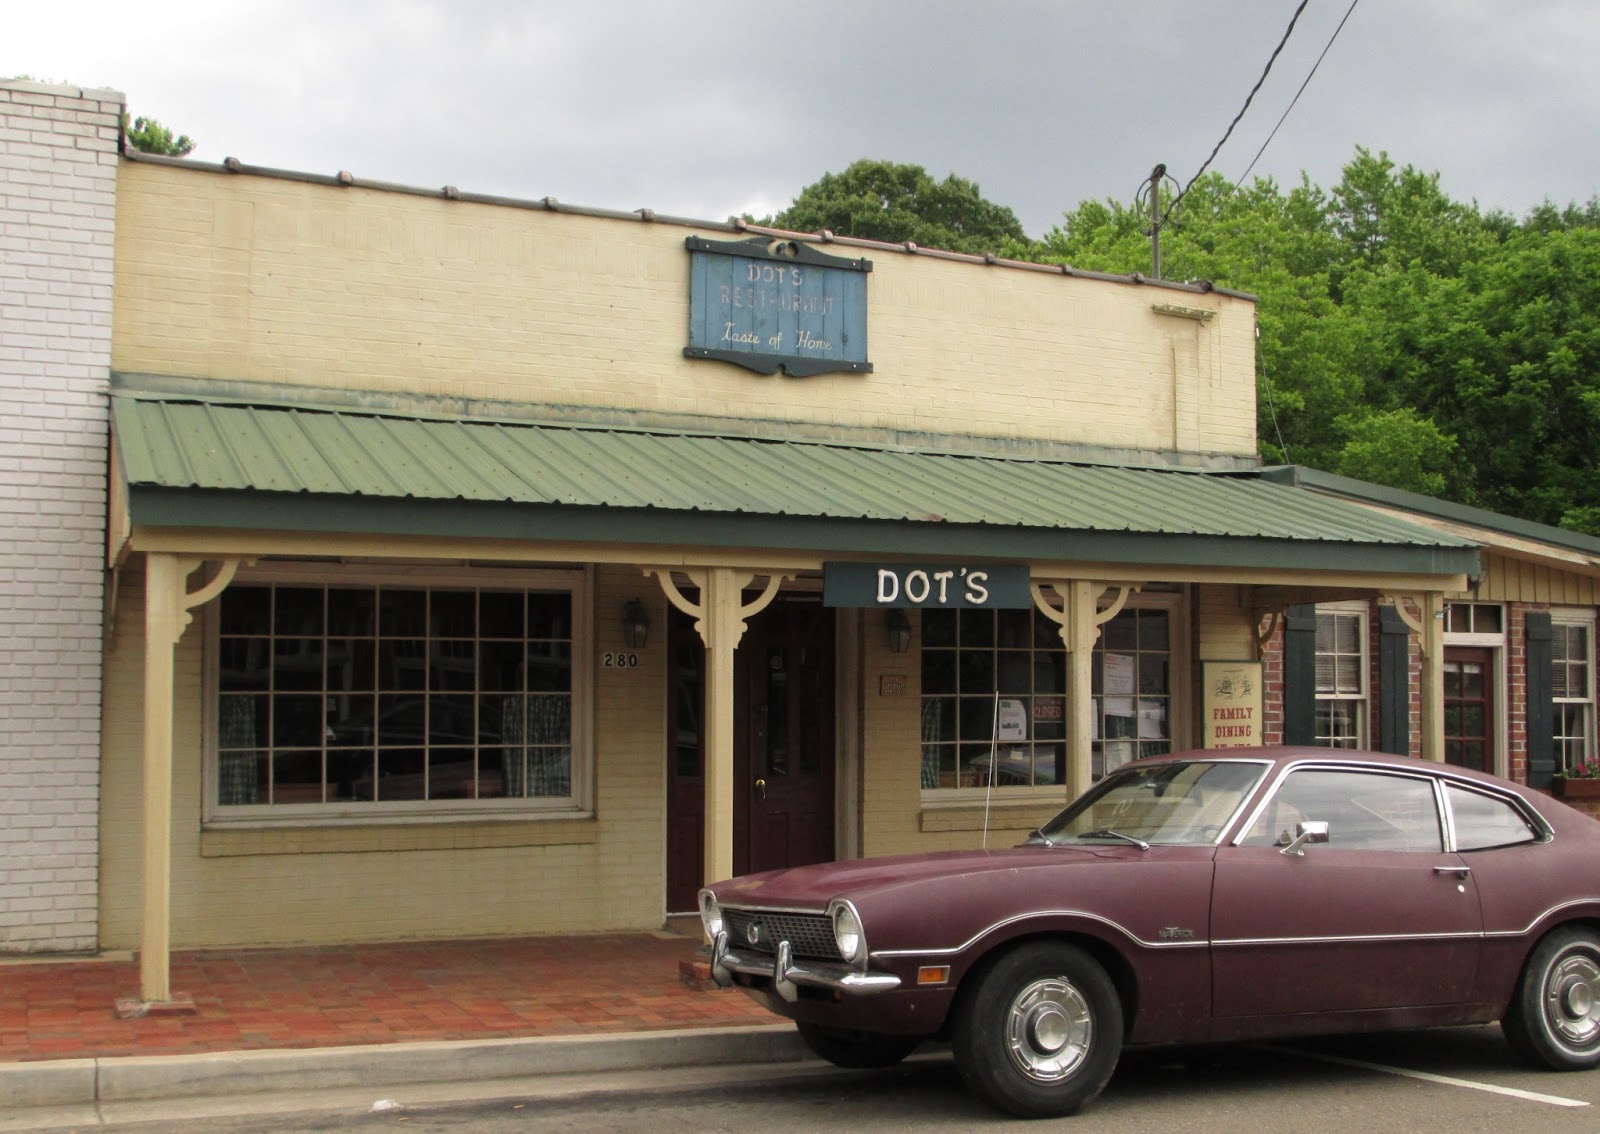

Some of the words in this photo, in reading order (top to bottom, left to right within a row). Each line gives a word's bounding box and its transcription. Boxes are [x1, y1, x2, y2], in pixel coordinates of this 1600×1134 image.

[747, 263, 804, 287] DOT'S
[721, 322, 760, 344] Taste
[768, 331, 783, 350] of
[796, 330, 833, 351] Home
[876, 567, 989, 605] DOT'S
[604, 653, 638, 668] 280
[1034, 706, 1062, 719] CLOSED
[1213, 707, 1253, 721] FAMILY
[1215, 725, 1252, 738] DINING
